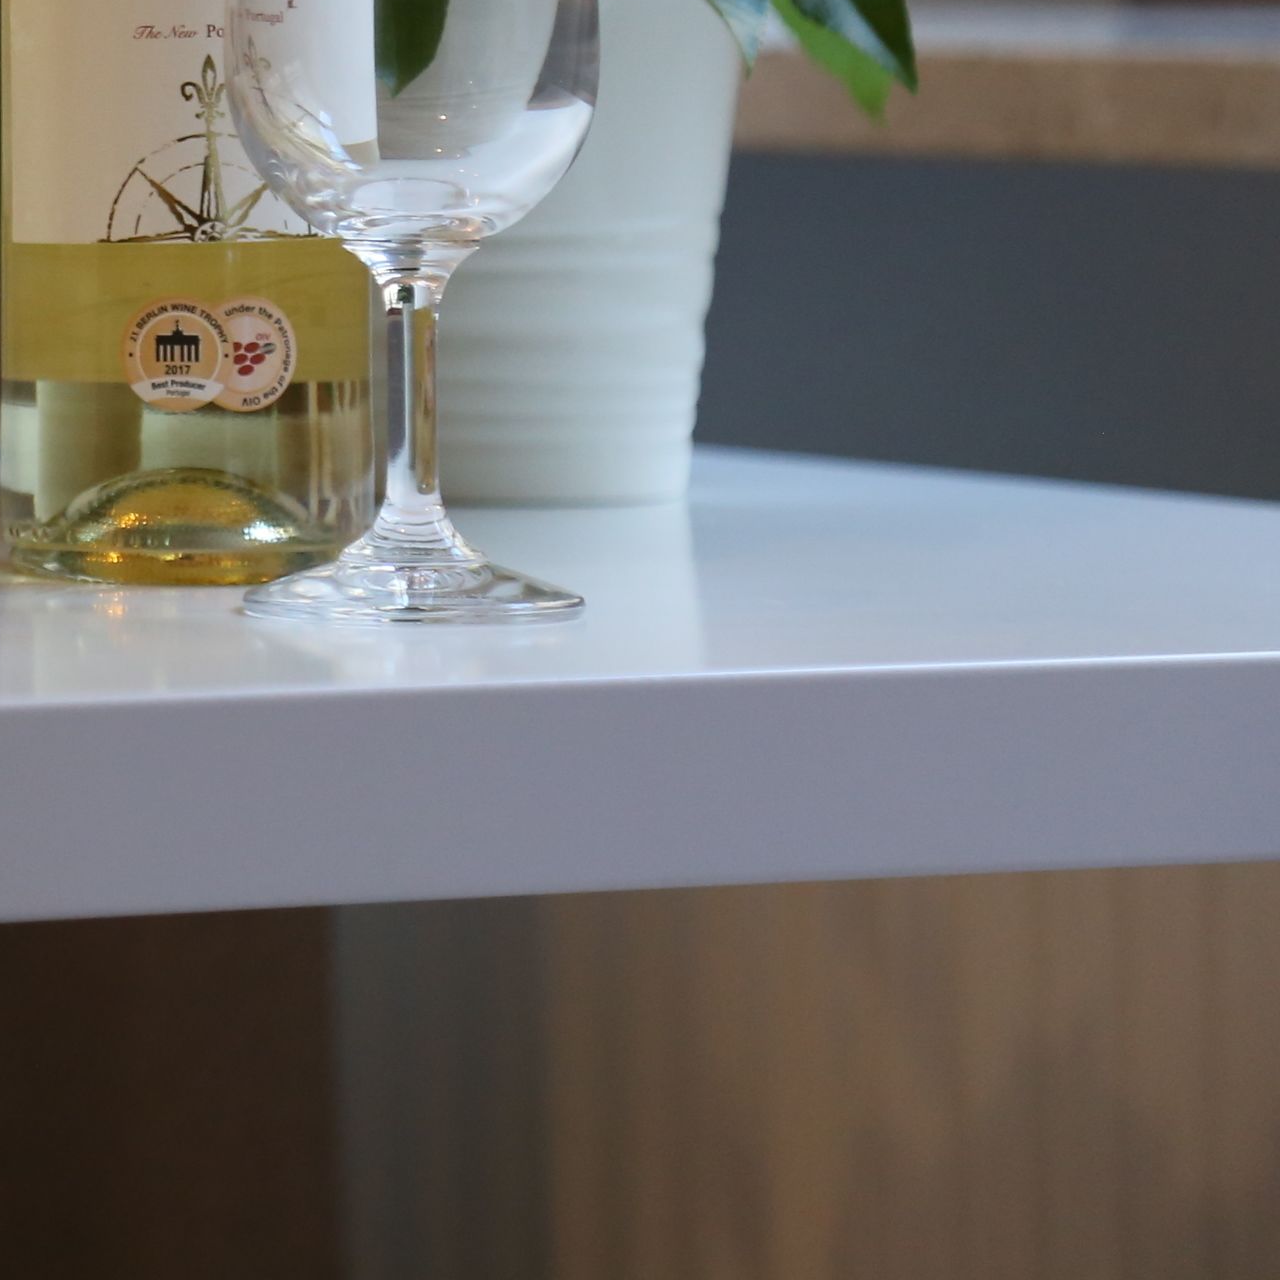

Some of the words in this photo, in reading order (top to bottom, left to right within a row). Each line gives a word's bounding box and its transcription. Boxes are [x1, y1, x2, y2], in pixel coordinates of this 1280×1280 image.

[132, 24, 162, 39] The
[164, 24, 198, 39] New
[224, 303, 257, 317] under
[258, 306, 274, 320] the
[137, 304, 169, 330] BERLIN
[171, 303, 198, 314] WINE
[200, 309, 229, 344] TROPHY
[164, 365, 192, 375] 2017
